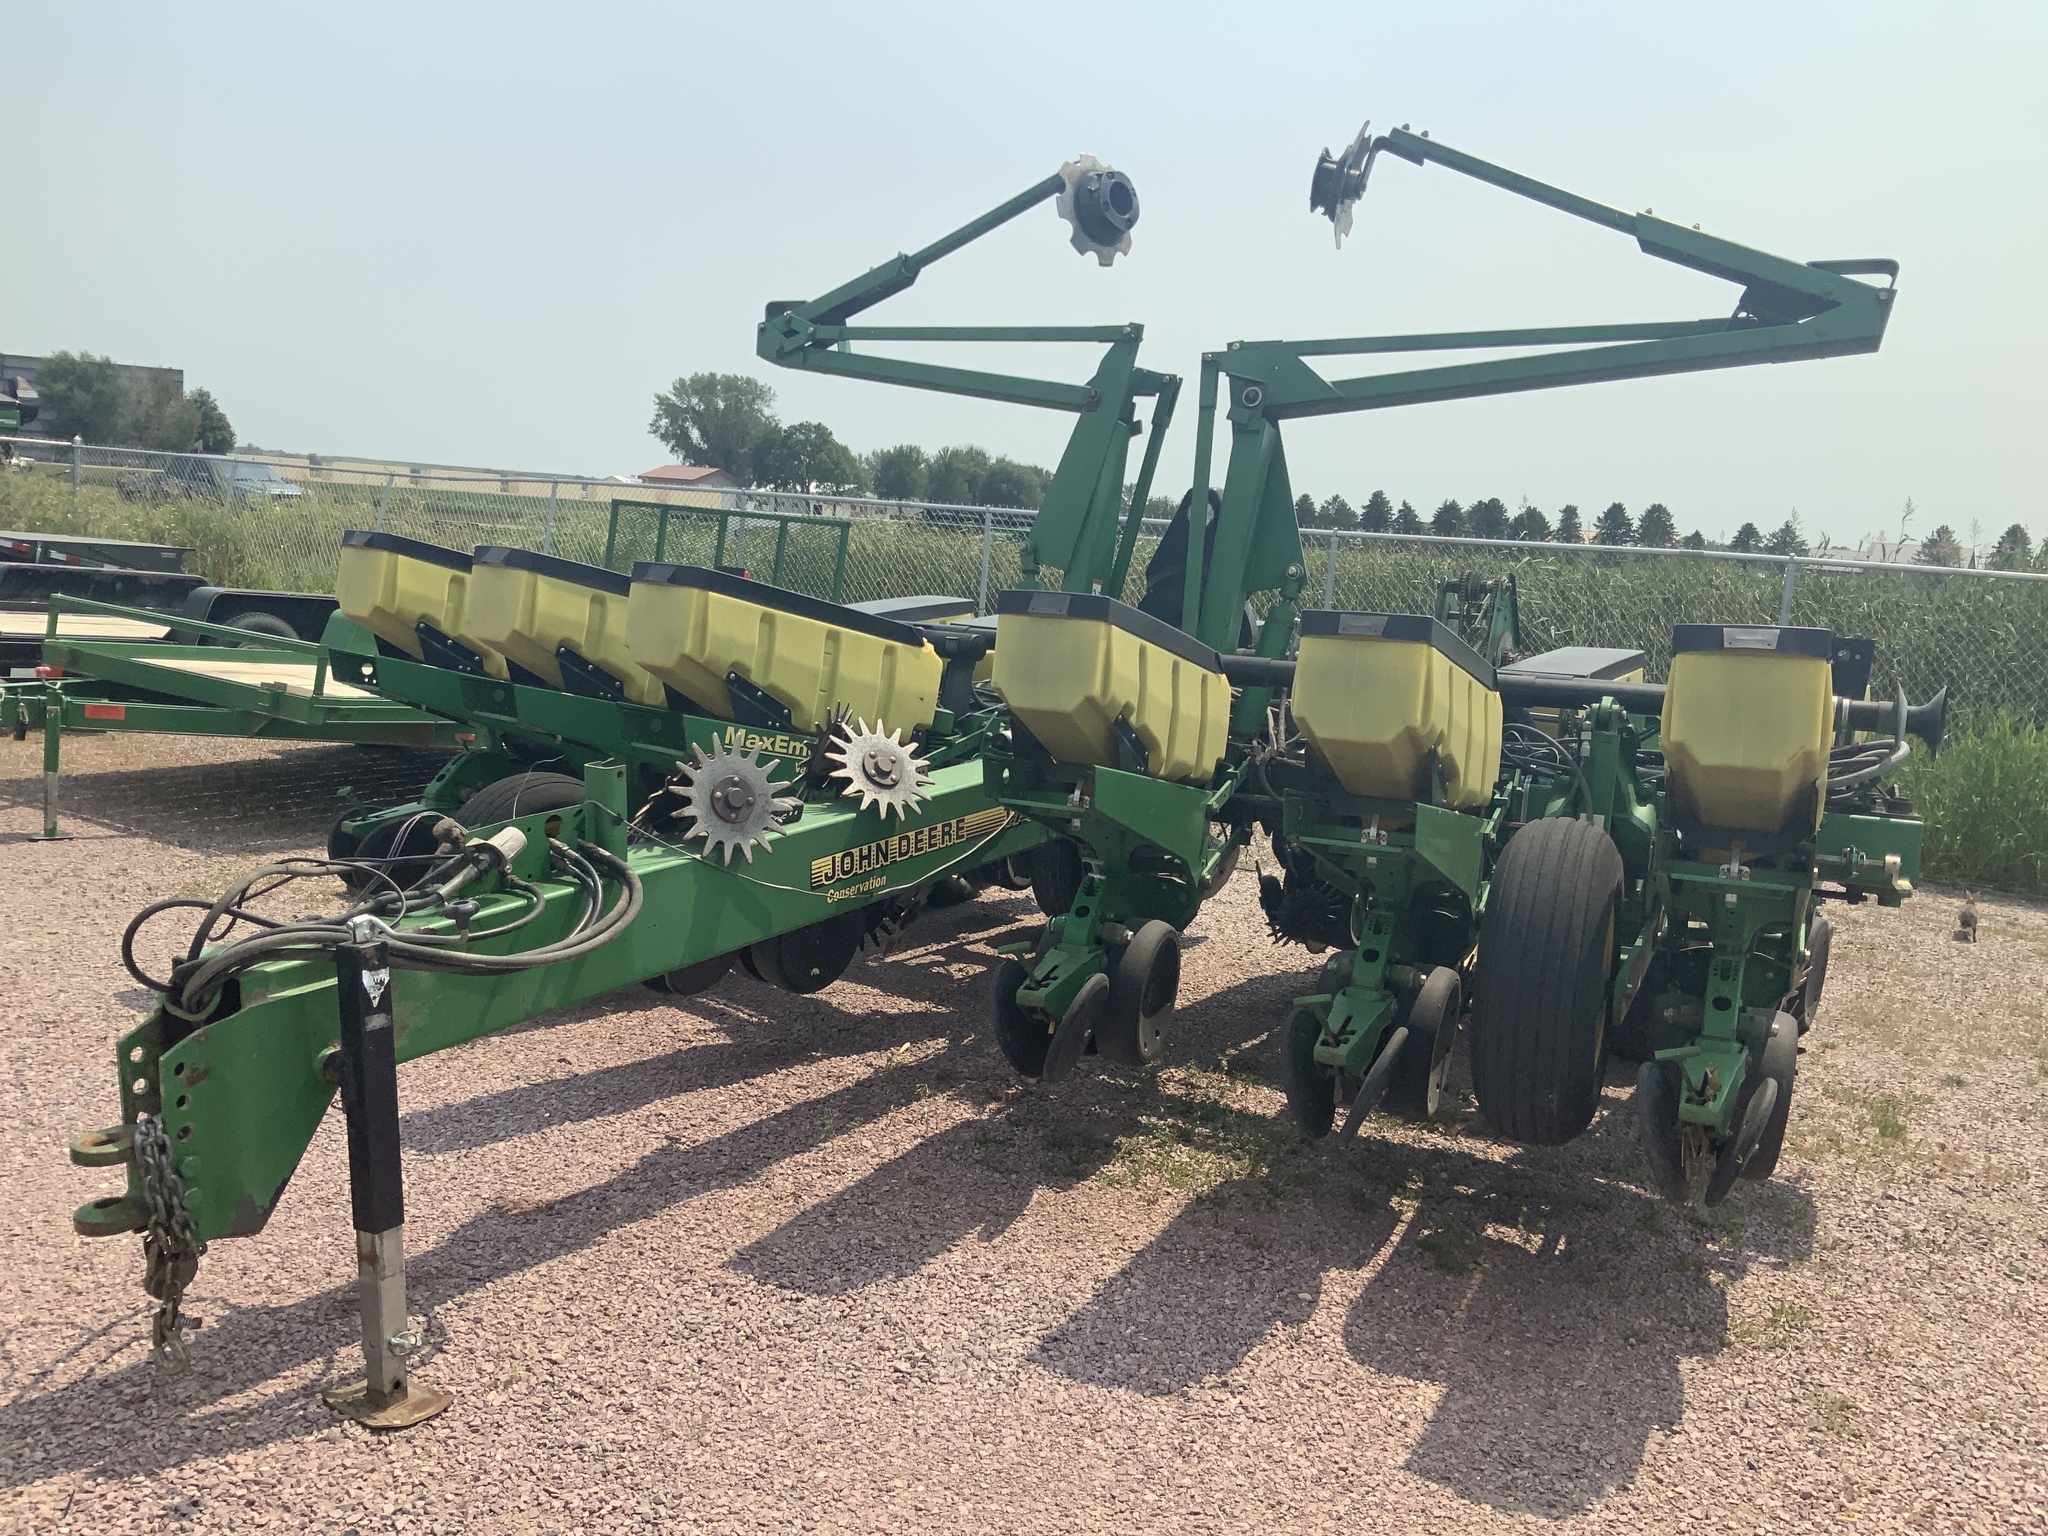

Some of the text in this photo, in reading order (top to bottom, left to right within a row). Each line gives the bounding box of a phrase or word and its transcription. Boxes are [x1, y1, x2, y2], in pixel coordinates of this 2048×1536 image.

[823, 839, 890, 884] JOHN
[897, 817, 966, 861] DEERE
[826, 874, 887, 904] Conservation
